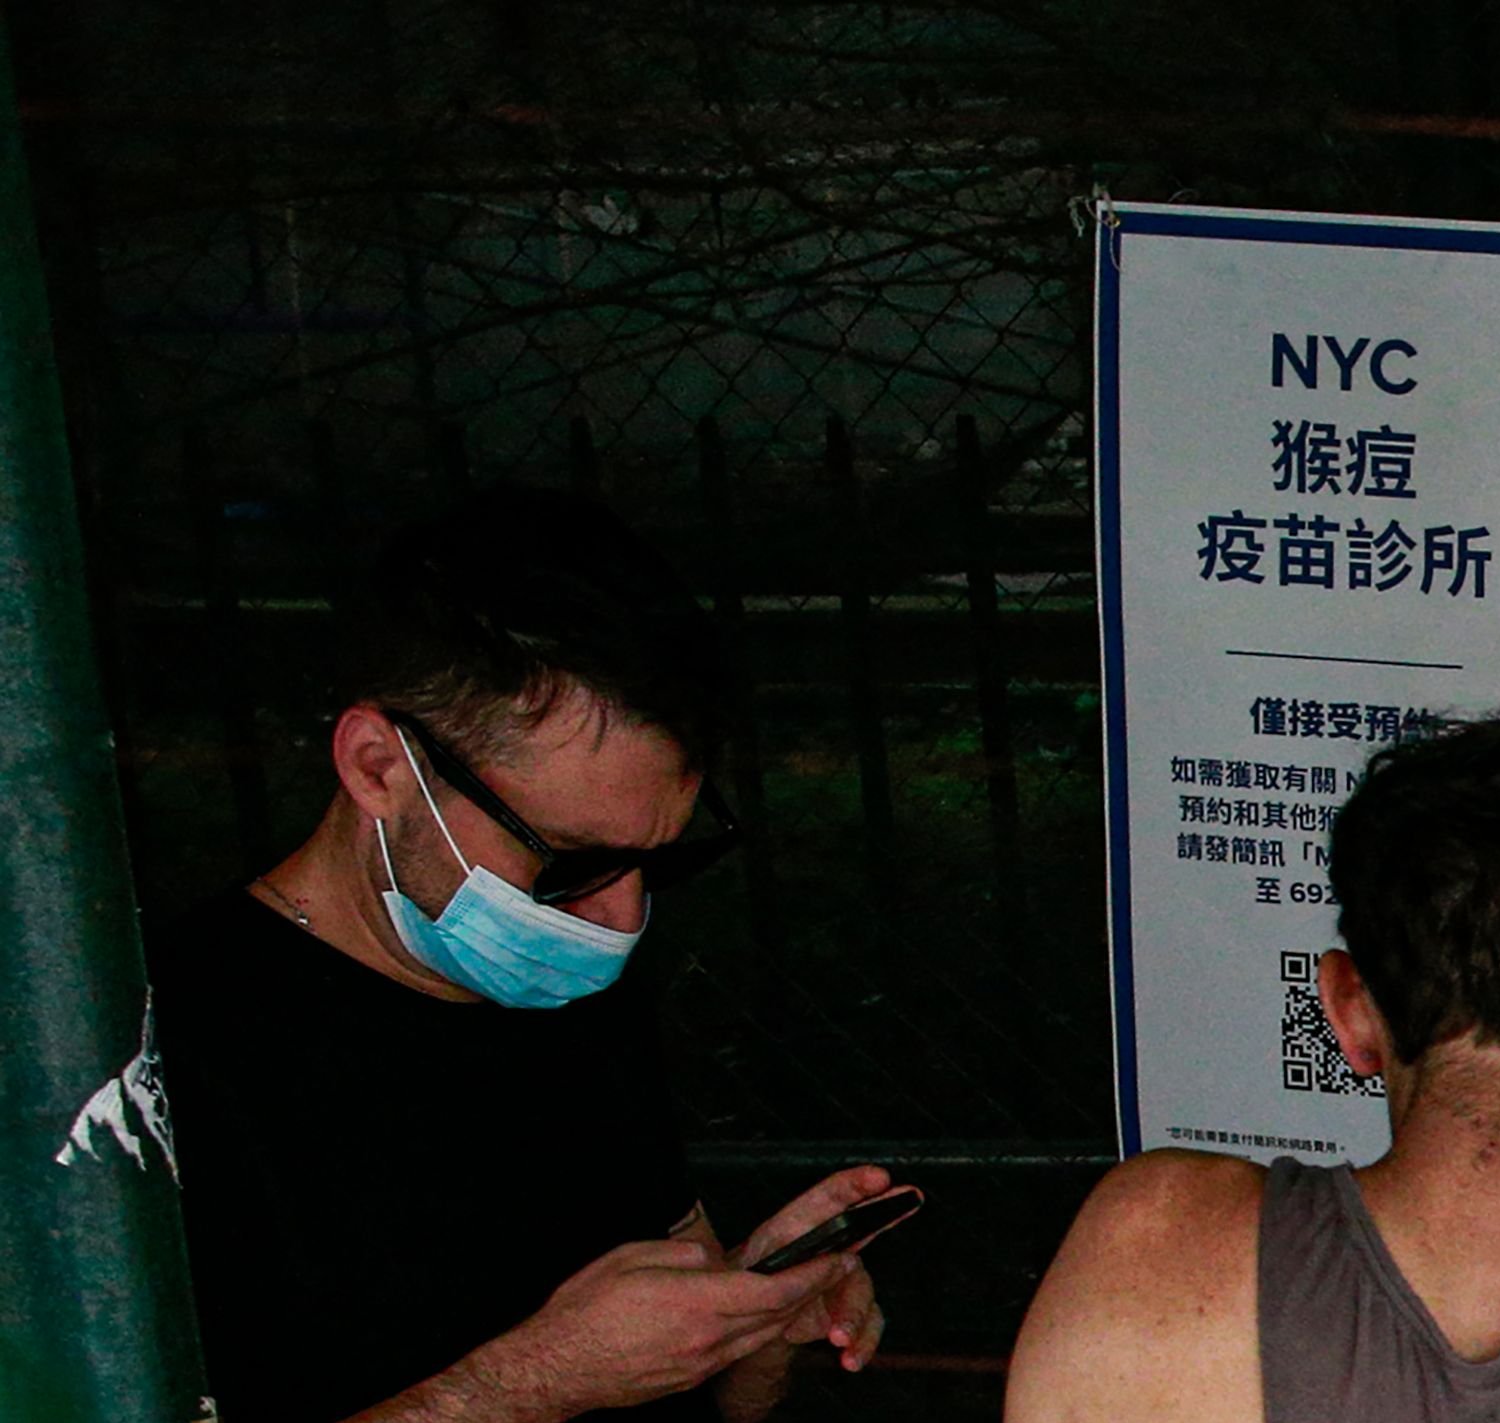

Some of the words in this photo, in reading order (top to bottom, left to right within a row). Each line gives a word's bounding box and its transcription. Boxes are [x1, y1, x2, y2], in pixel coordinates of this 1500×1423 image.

[1271, 333, 1418, 396] NYC
[1271, 419, 1417, 499] 猴痘
[1197, 509, 1492, 599] 疫苗診所
